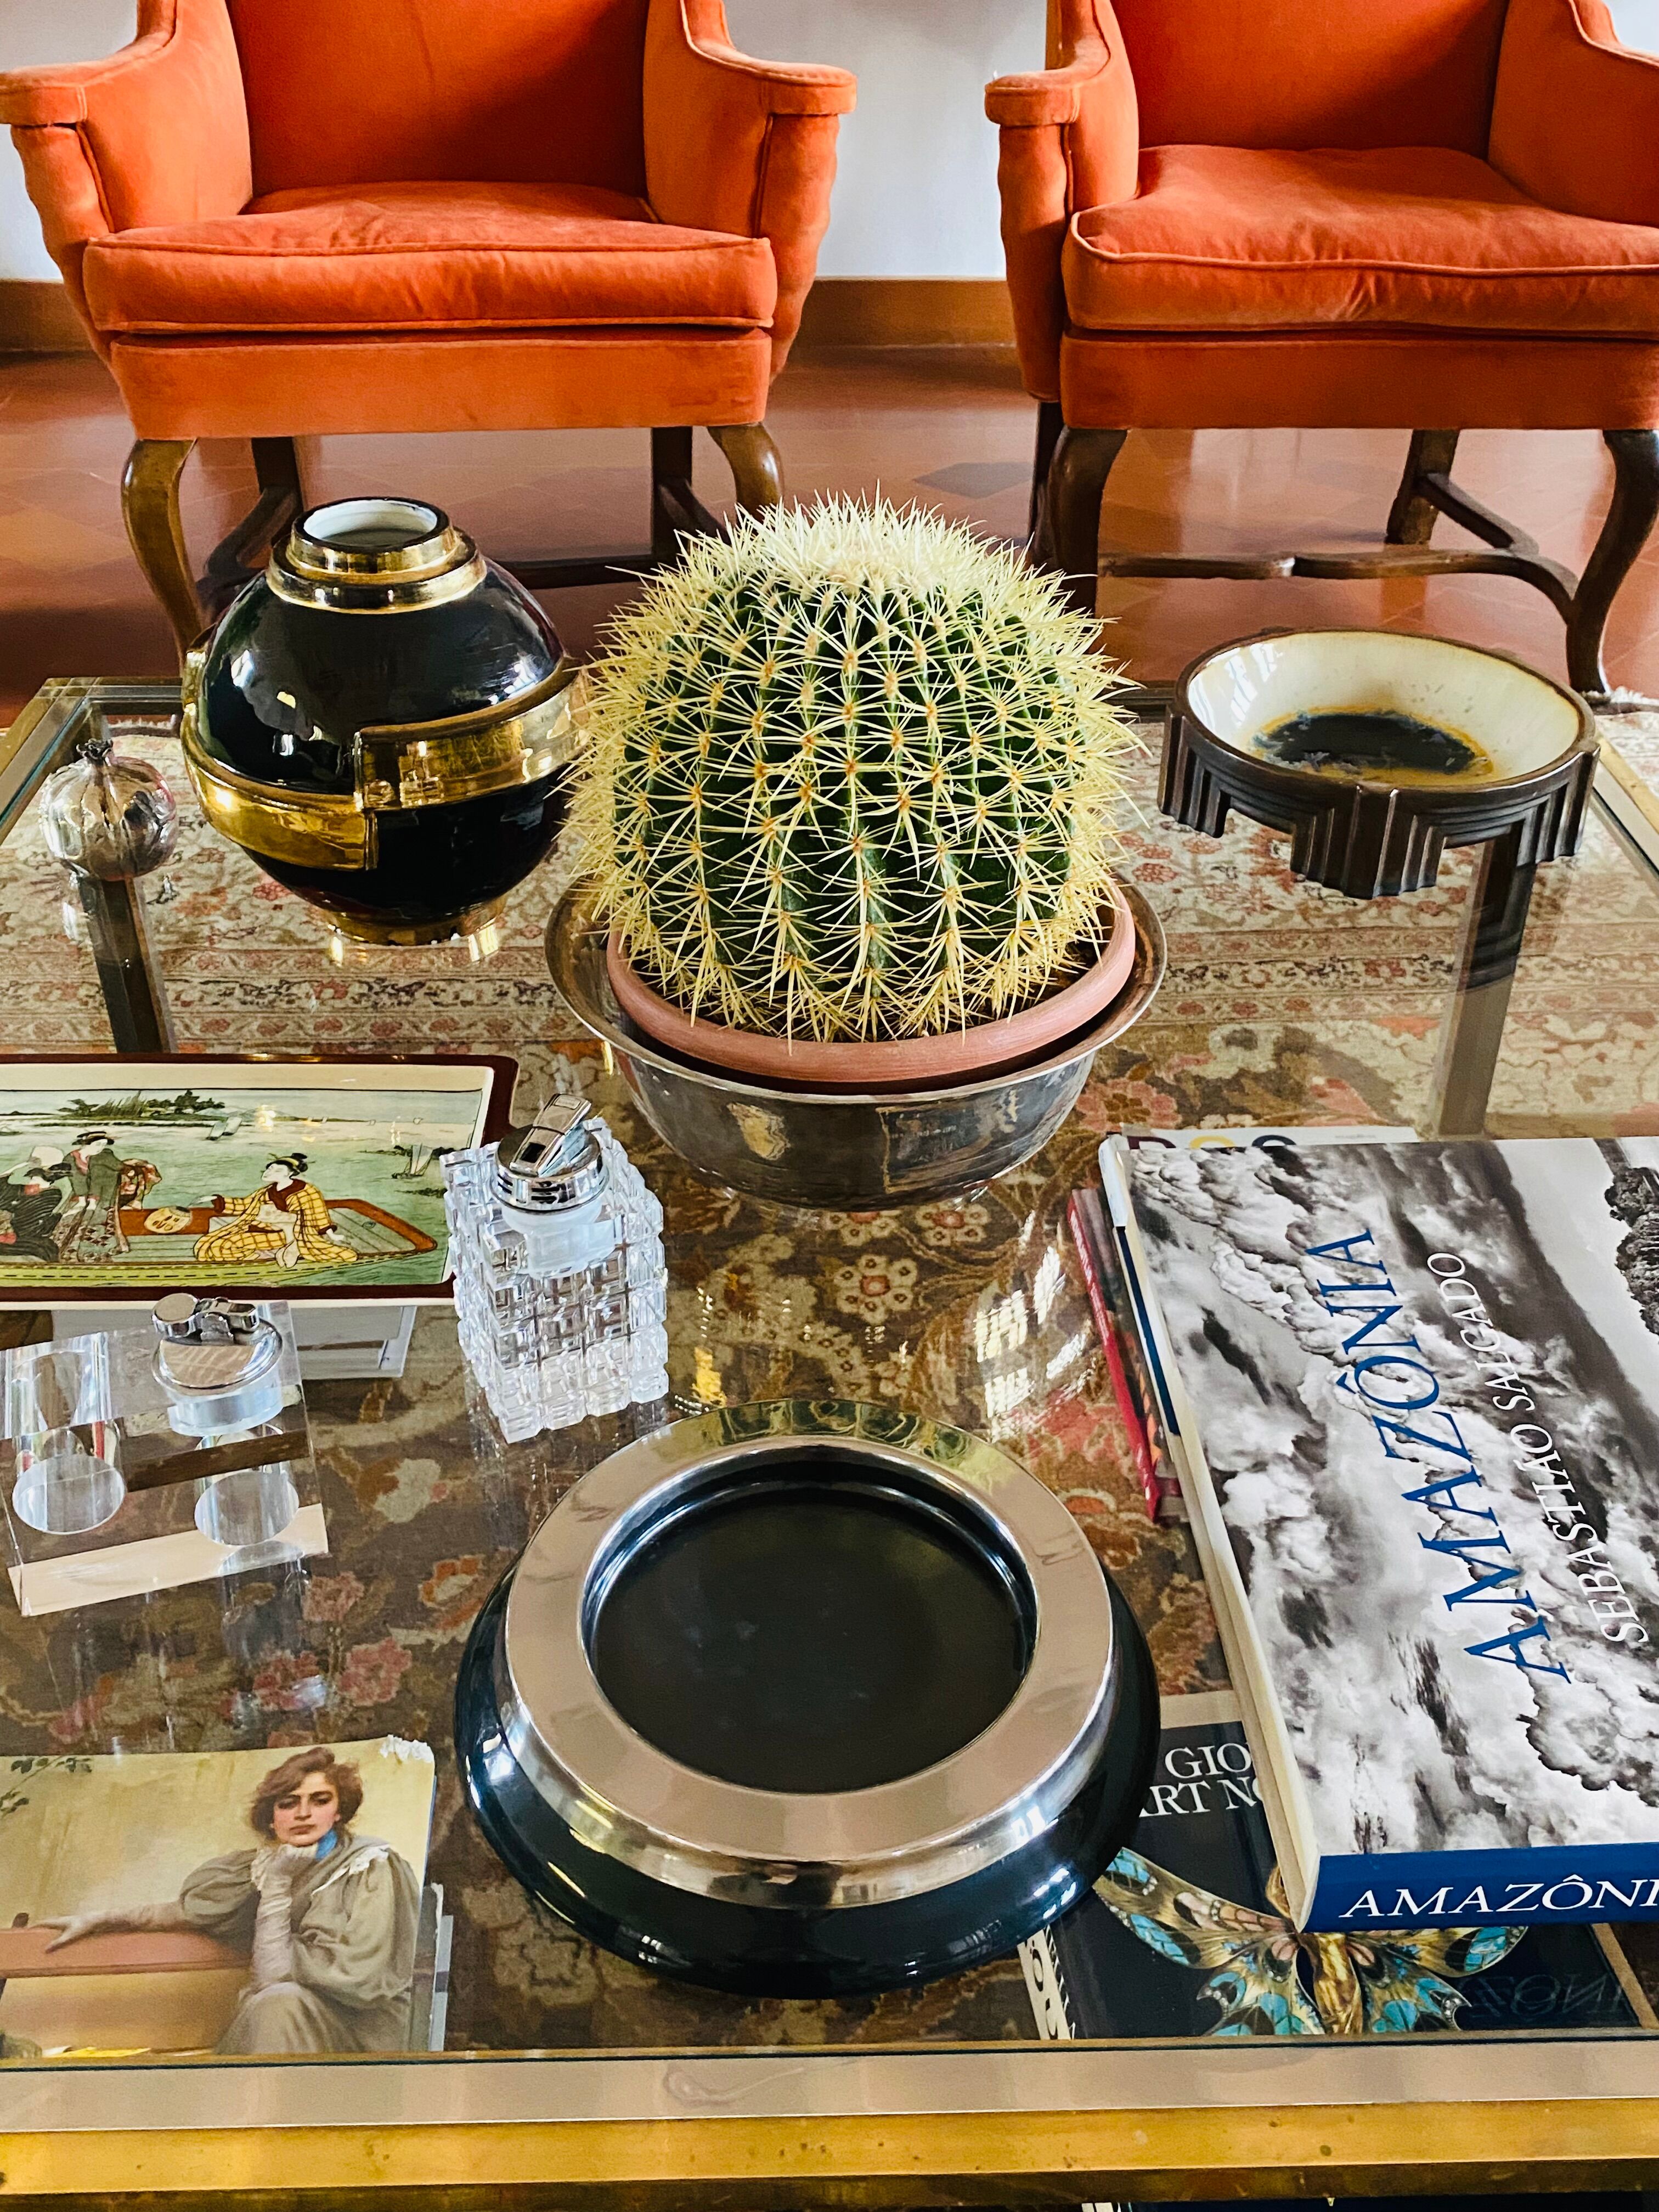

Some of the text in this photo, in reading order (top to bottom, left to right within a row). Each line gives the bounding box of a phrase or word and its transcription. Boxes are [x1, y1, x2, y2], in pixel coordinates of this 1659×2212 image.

[1306, 1229, 1571, 1683] AMAZÔNIA
[1427, 1253, 1649, 1643] SEBASTIÃO SALGADO
[1139, 1780, 1211, 1817] RT
[1165, 1743, 1252, 1779] GIO
